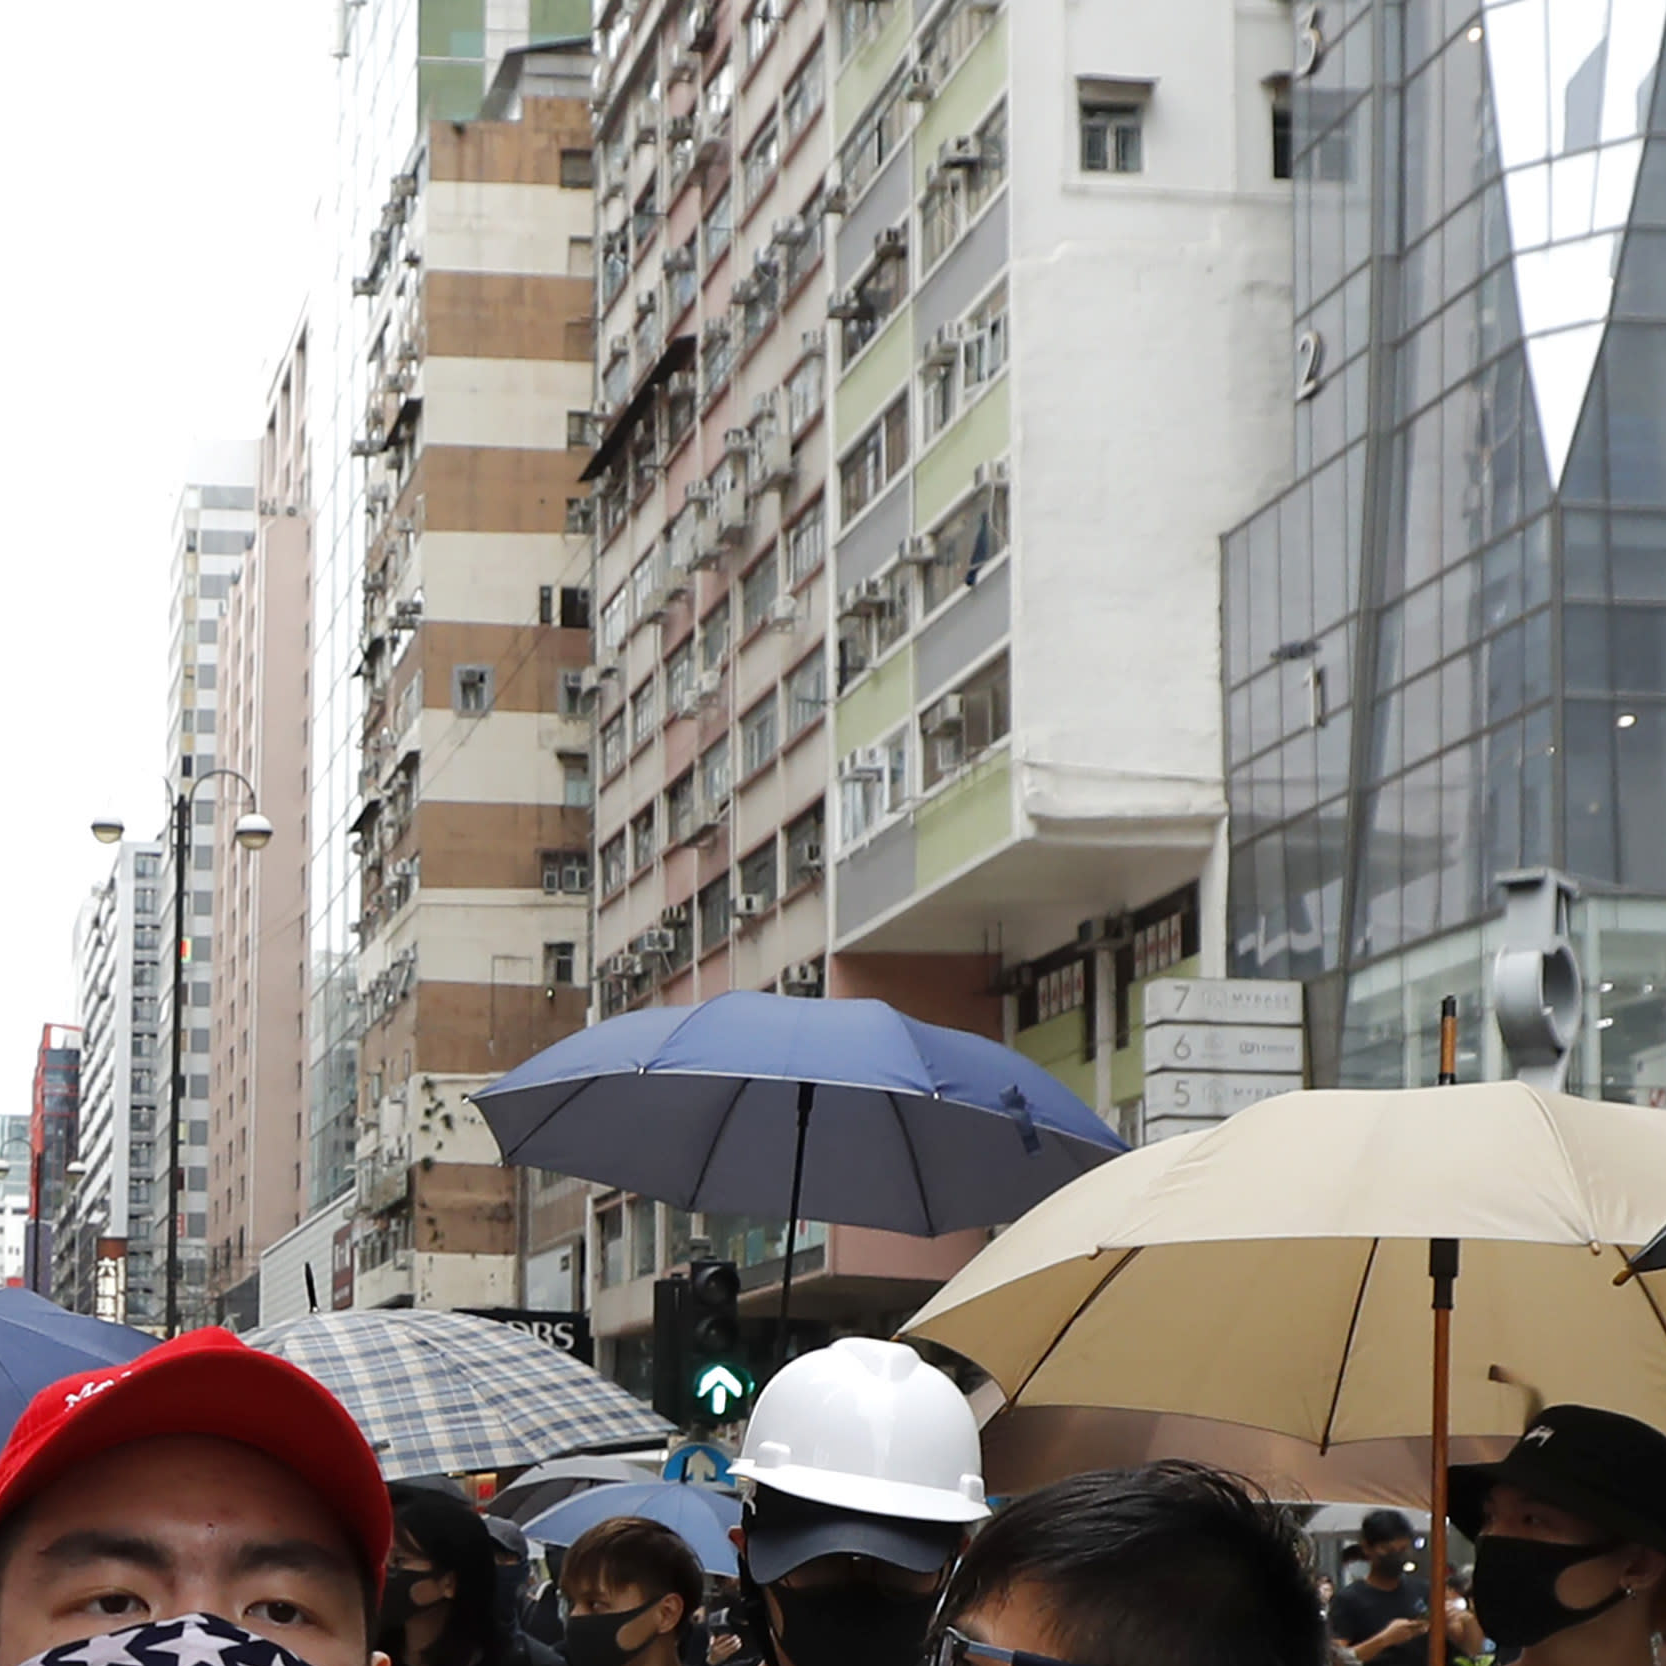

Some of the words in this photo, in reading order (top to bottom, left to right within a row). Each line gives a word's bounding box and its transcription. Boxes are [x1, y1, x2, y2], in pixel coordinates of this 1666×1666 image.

[1174, 984, 1191, 1013] 7
[1174, 1034, 1191, 1061] 6
[1174, 1080, 1191, 1107] 5
